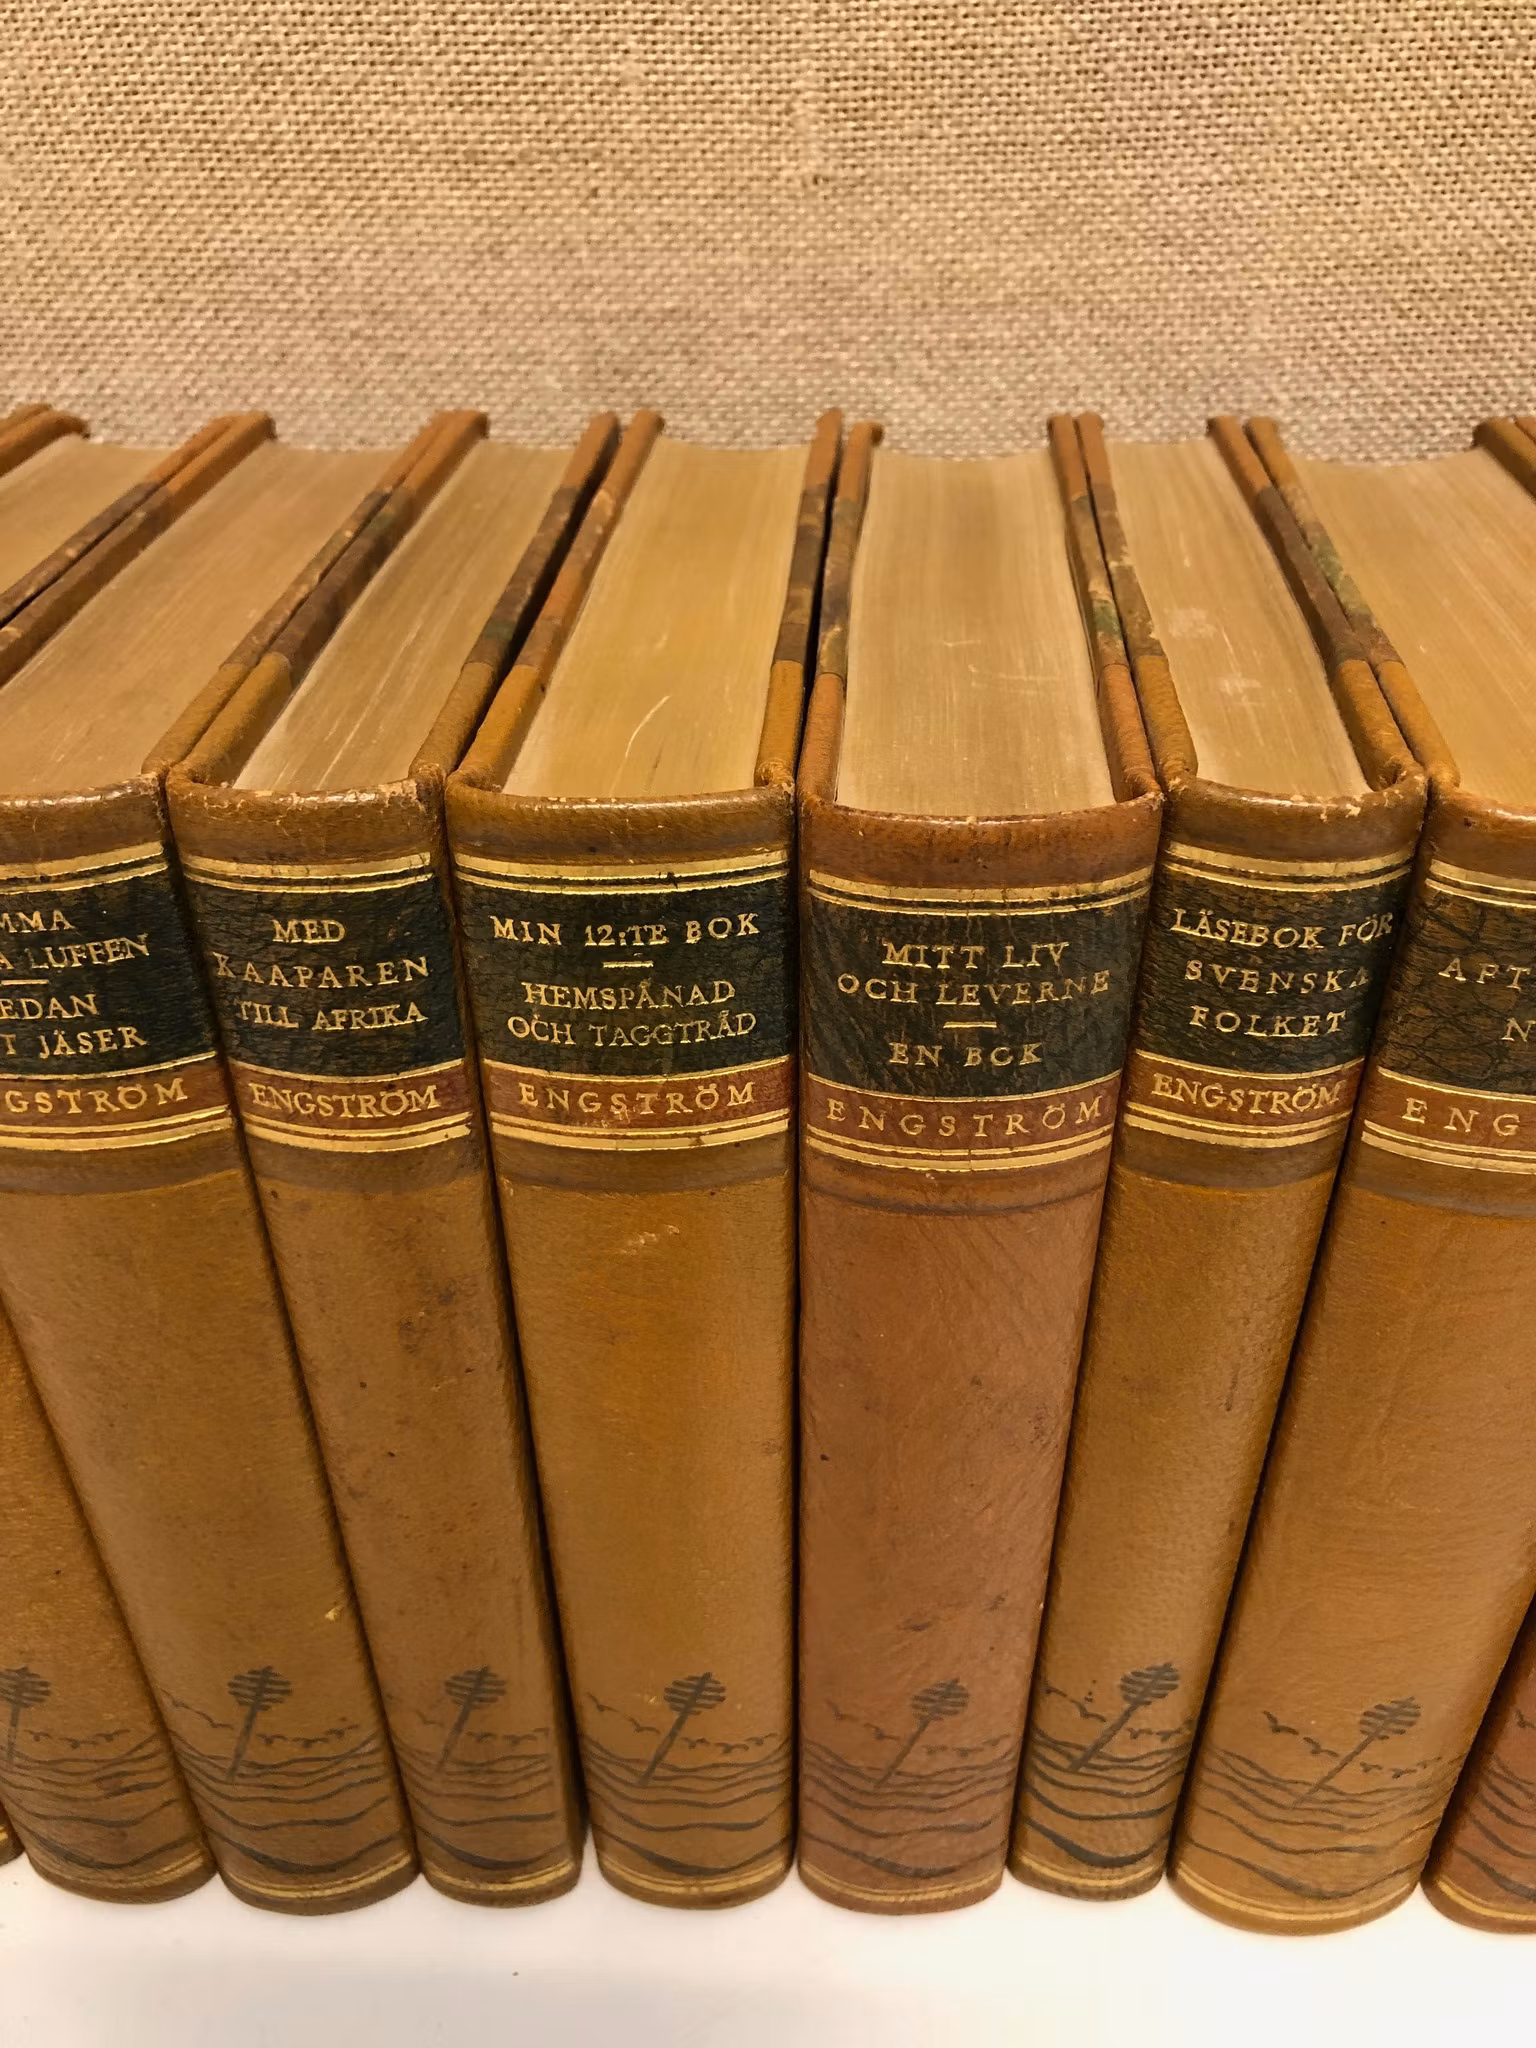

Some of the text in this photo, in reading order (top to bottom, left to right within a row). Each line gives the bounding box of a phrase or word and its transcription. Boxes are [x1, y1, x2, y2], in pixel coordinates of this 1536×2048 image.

[271, 919, 347, 943] MED
[490, 913, 760, 946] MIN 12:TE BOK
[1170, 908, 1394, 949] LÄSEBOK FÖR
[25, 933, 150, 969] LUFFEN
[882, 941, 1070, 969] MITT LIV
[213, 951, 429, 988] KAAPAREN
[1184, 959, 1369, 994] SVENSKA
[521, 977, 735, 1010] HEMSPÅNAD
[837, 970, 1110, 1006] OCH LEVERNE
[235, 1001, 428, 1031] TILL AFRIKA
[507, 1009, 757, 1047] OCH TAGGTRÅD
[1189, 1004, 1346, 1038] FOLKET
[37, 1026, 147, 1059] JÄSER
[888, 1042, 942, 1067] EN
[4, 1078, 188, 1114] GSTRÖM
[248, 1083, 441, 1118] ENGSTRÖM
[518, 1082, 756, 1115] ENGSTRÖM
[1151, 1073, 1347, 1114] ENGSTRÖM
[826, 1096, 1102, 1137] ENGSTRÖM
[1401, 1097, 1521, 1137] ENG
